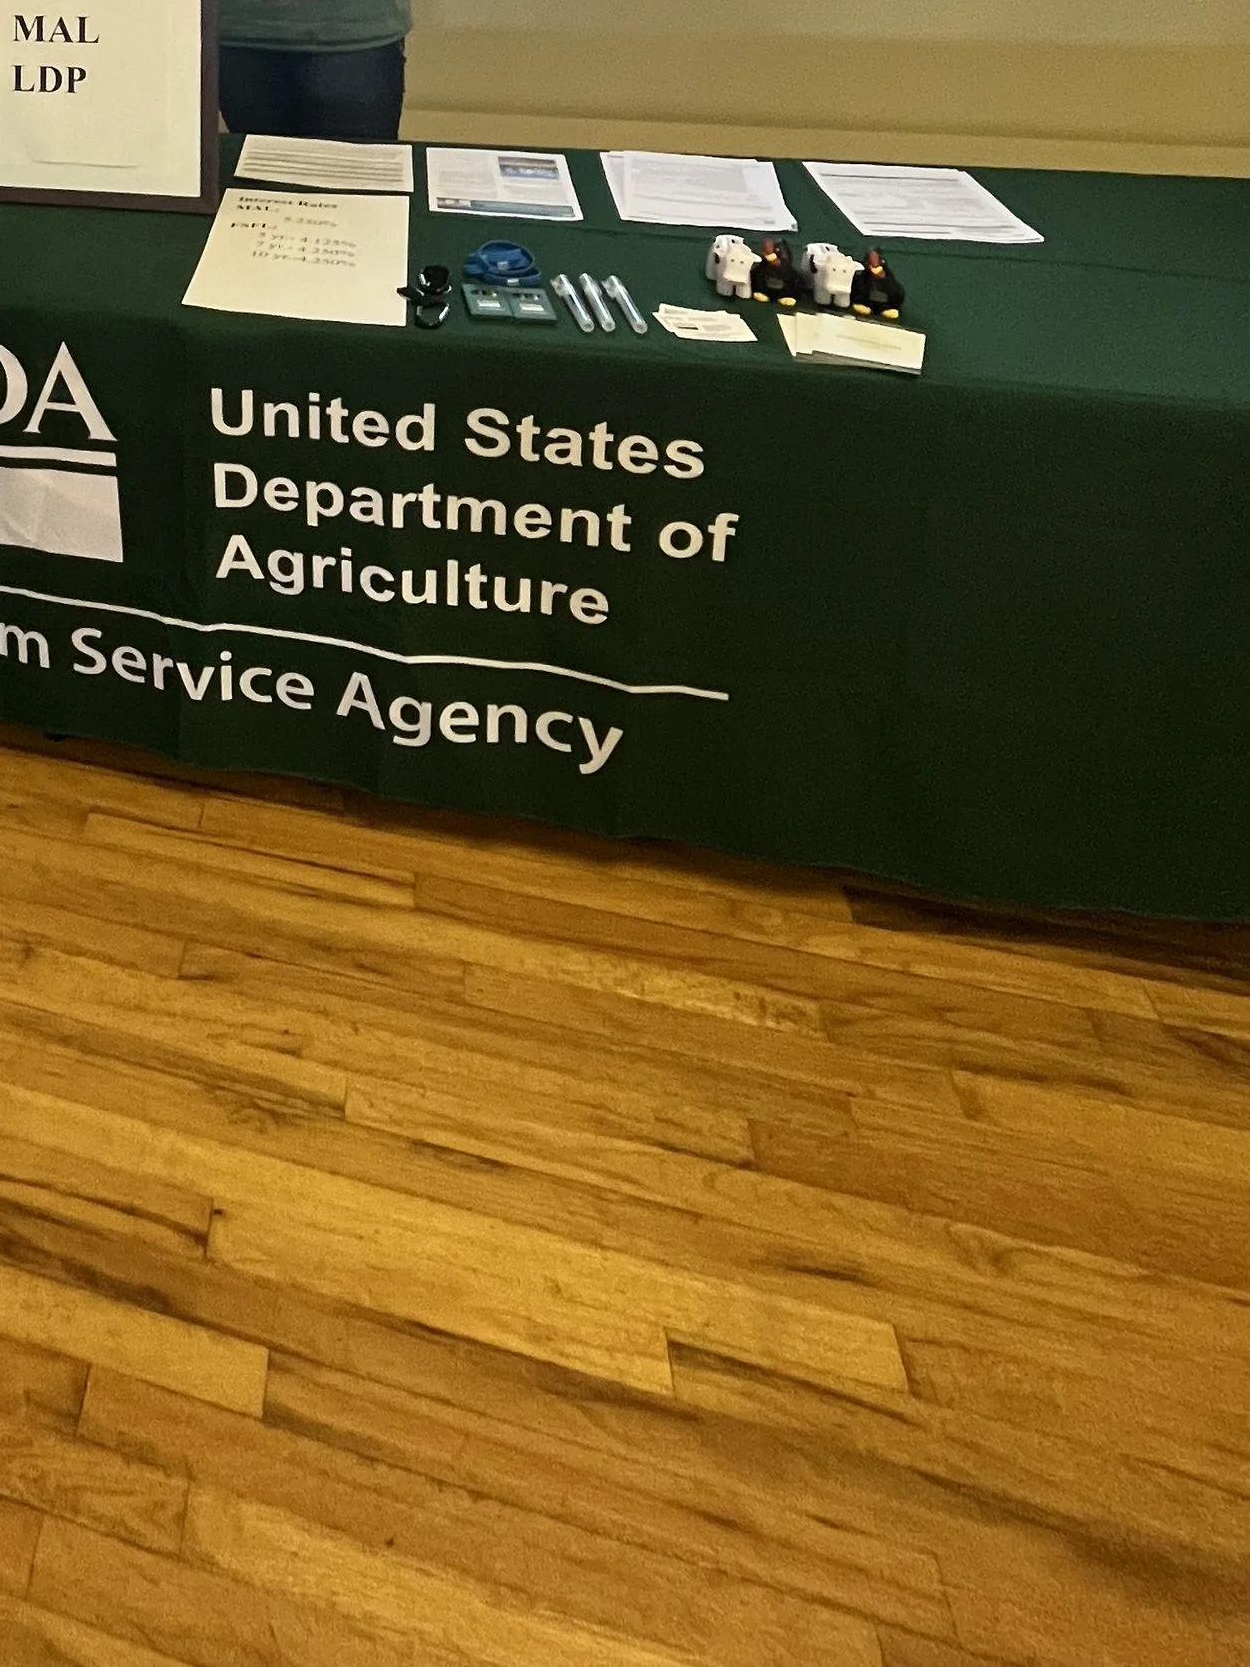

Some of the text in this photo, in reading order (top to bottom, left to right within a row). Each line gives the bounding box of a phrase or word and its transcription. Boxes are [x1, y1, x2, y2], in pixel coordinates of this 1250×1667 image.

[13, 14, 100, 44] MAL
[13, 64, 87, 94] LDP
[210, 387, 705, 479] United States
[213, 462, 740, 562] Department of
[215, 534, 609, 625] Agriculture
[71, 627, 315, 710] Service
[336, 671, 624, 775] Agency
